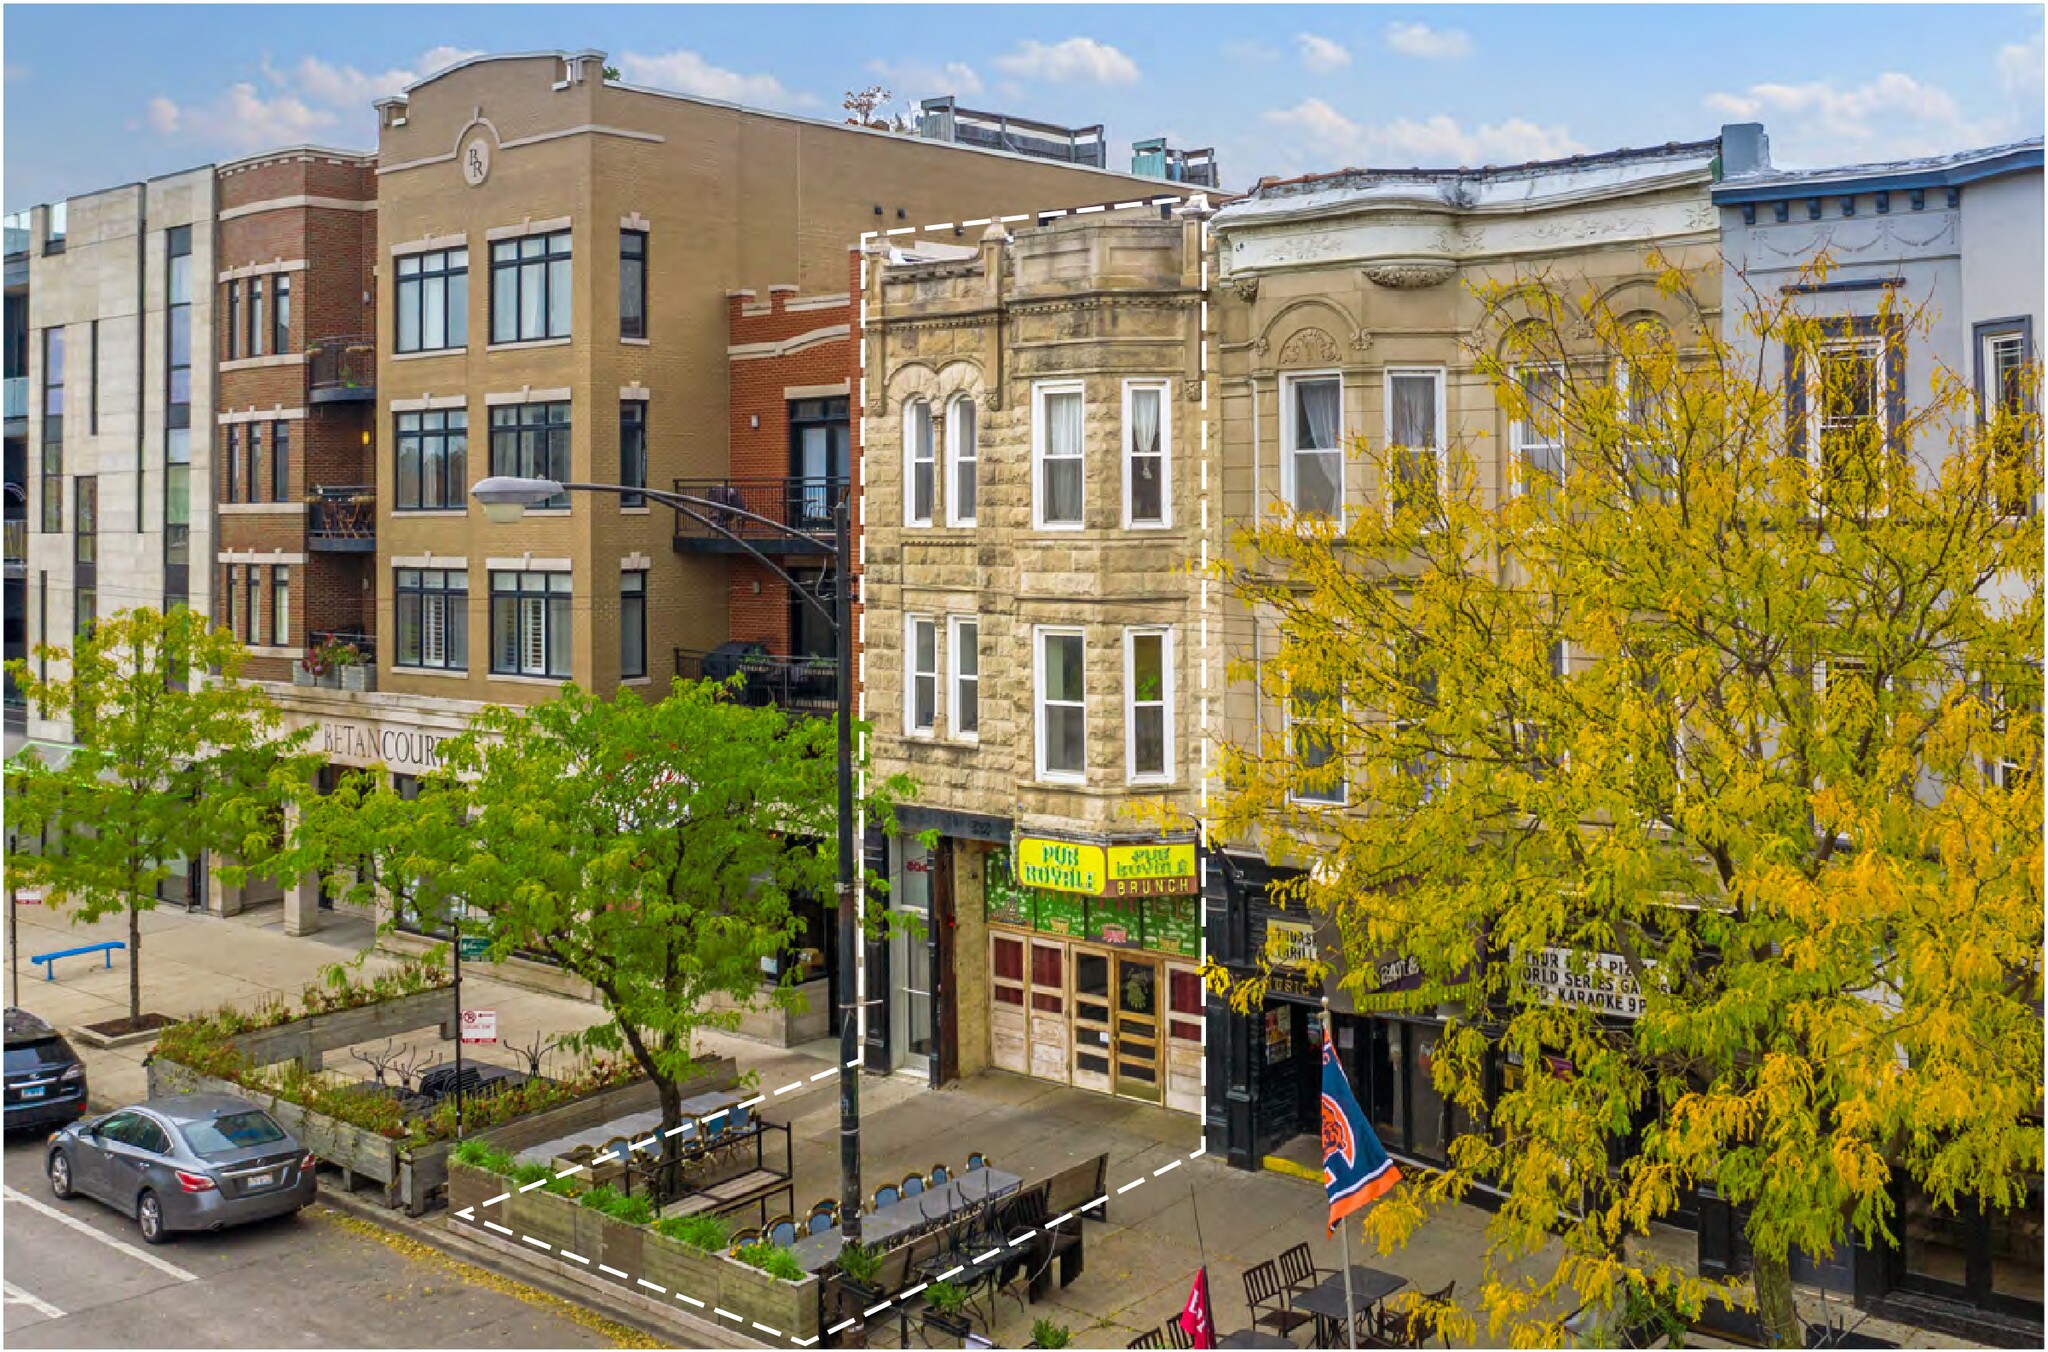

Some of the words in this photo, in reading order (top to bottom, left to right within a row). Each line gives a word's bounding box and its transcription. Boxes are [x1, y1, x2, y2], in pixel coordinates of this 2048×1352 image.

[1042, 841, 1079, 867] PUB
[1131, 846, 1171, 863] PUB
[1024, 861, 1096, 892] ROYALE
[1116, 859, 1188, 877] ROYALE
[1117, 878, 1189, 896] BRUNCH
[1519, 966, 1559, 984] ORLD
[1565, 971, 1614, 991] SERES
[1558, 987, 1623, 1010] KARAOKE
